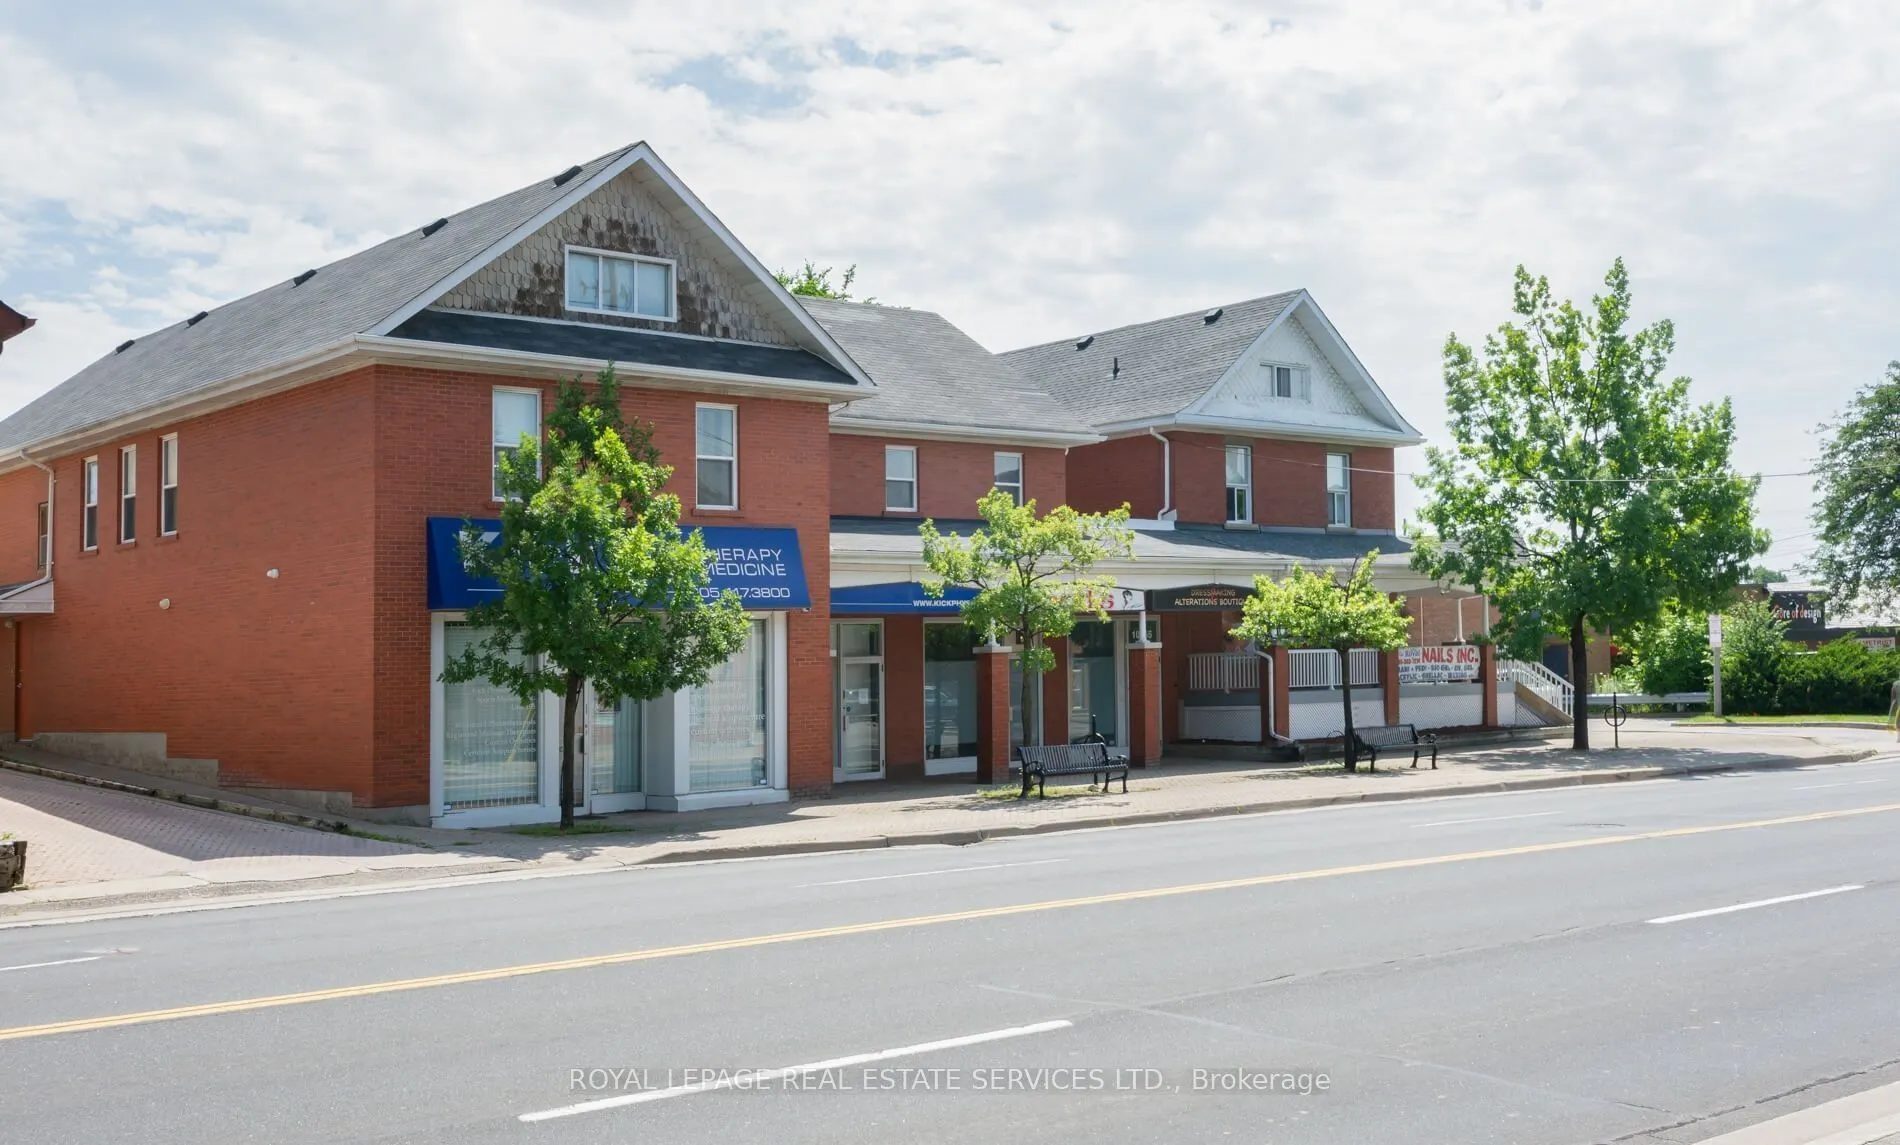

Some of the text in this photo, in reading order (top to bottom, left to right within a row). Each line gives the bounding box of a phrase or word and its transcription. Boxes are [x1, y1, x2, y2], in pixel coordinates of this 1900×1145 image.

[1174, 598, 1218, 606] ALTERATIONS
[1800, 604, 1822, 624] design
[1421, 647, 1454, 663] NAILS
[1457, 647, 1479, 662] INC.
